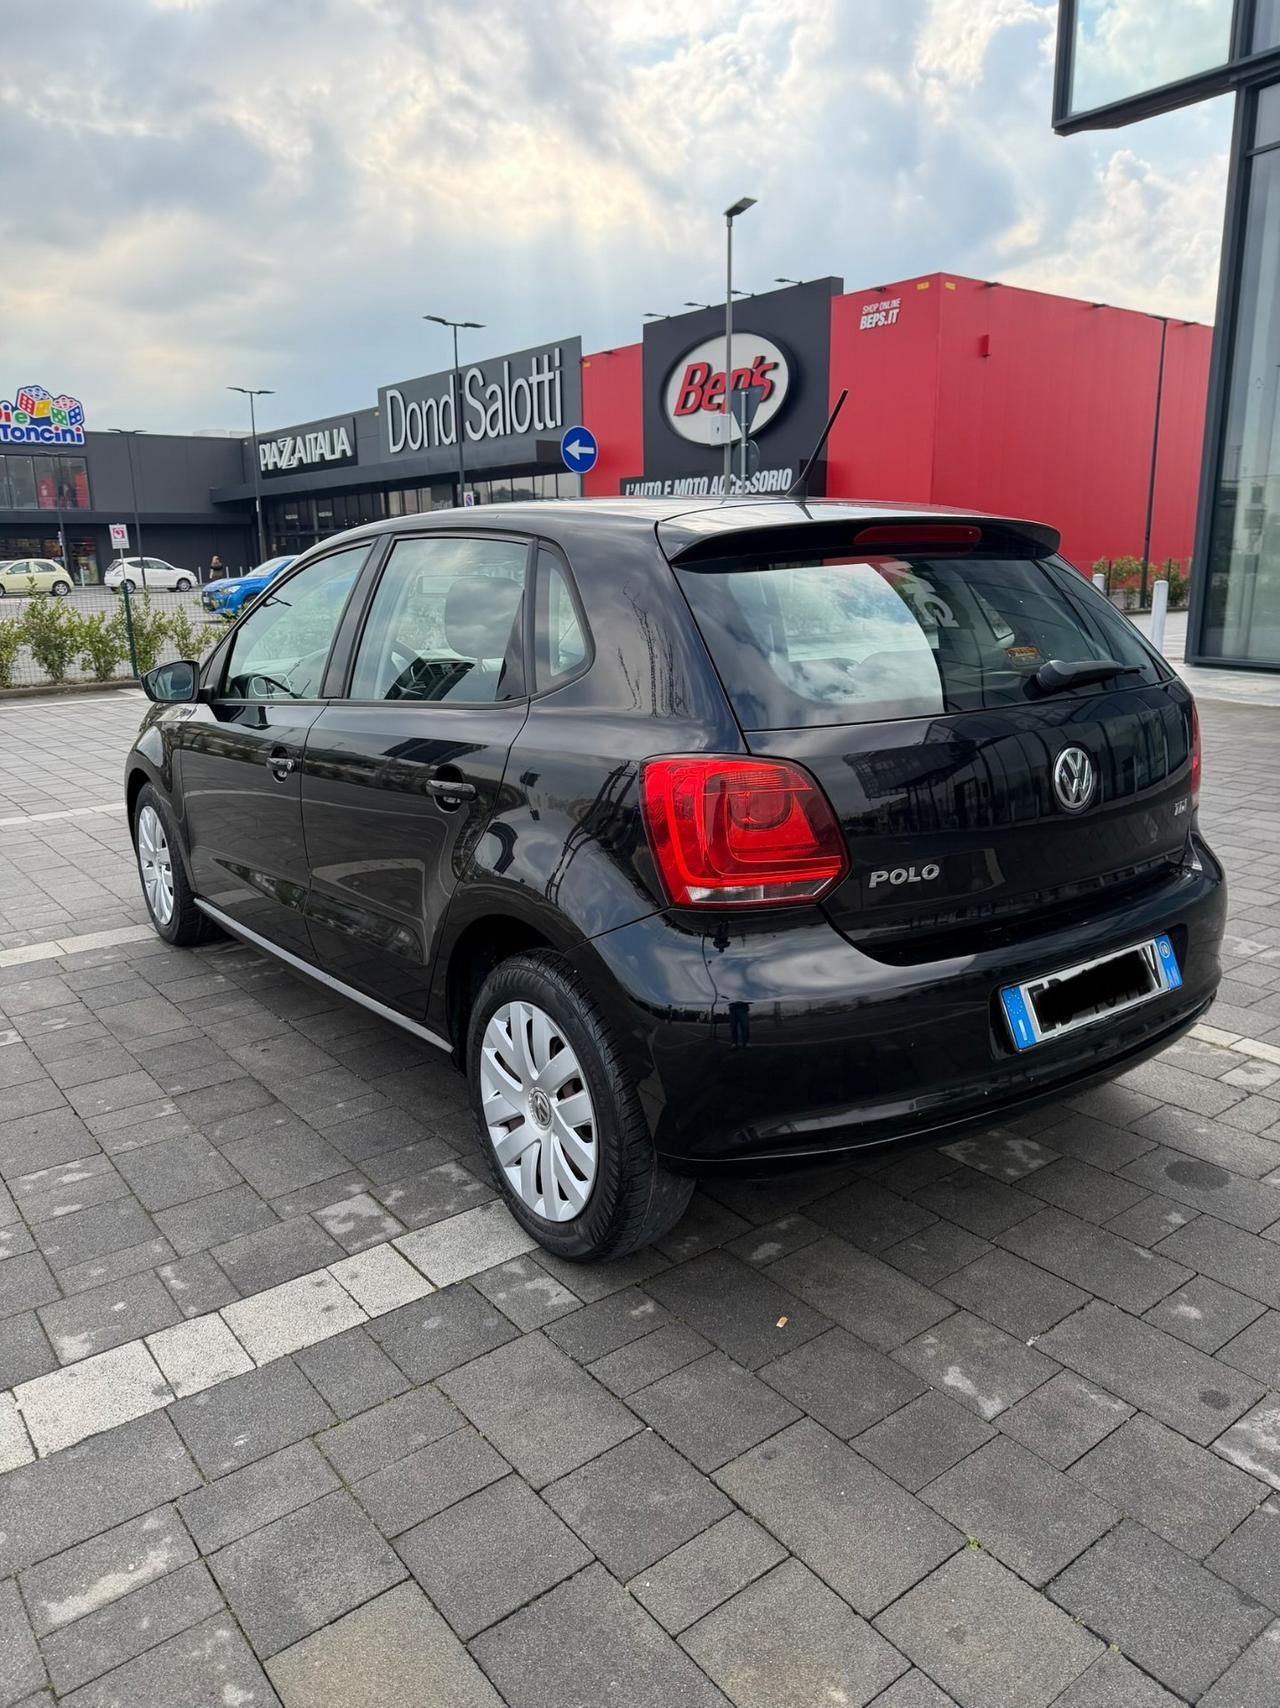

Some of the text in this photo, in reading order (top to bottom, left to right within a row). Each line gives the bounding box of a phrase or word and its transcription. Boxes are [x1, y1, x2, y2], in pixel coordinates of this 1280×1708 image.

[860, 308, 900, 330] BEPS.IT
[386, 347, 562, 453] Dond Salotti
[673, 478, 709, 496] MOTO
[868, 863, 940, 889] POLO
